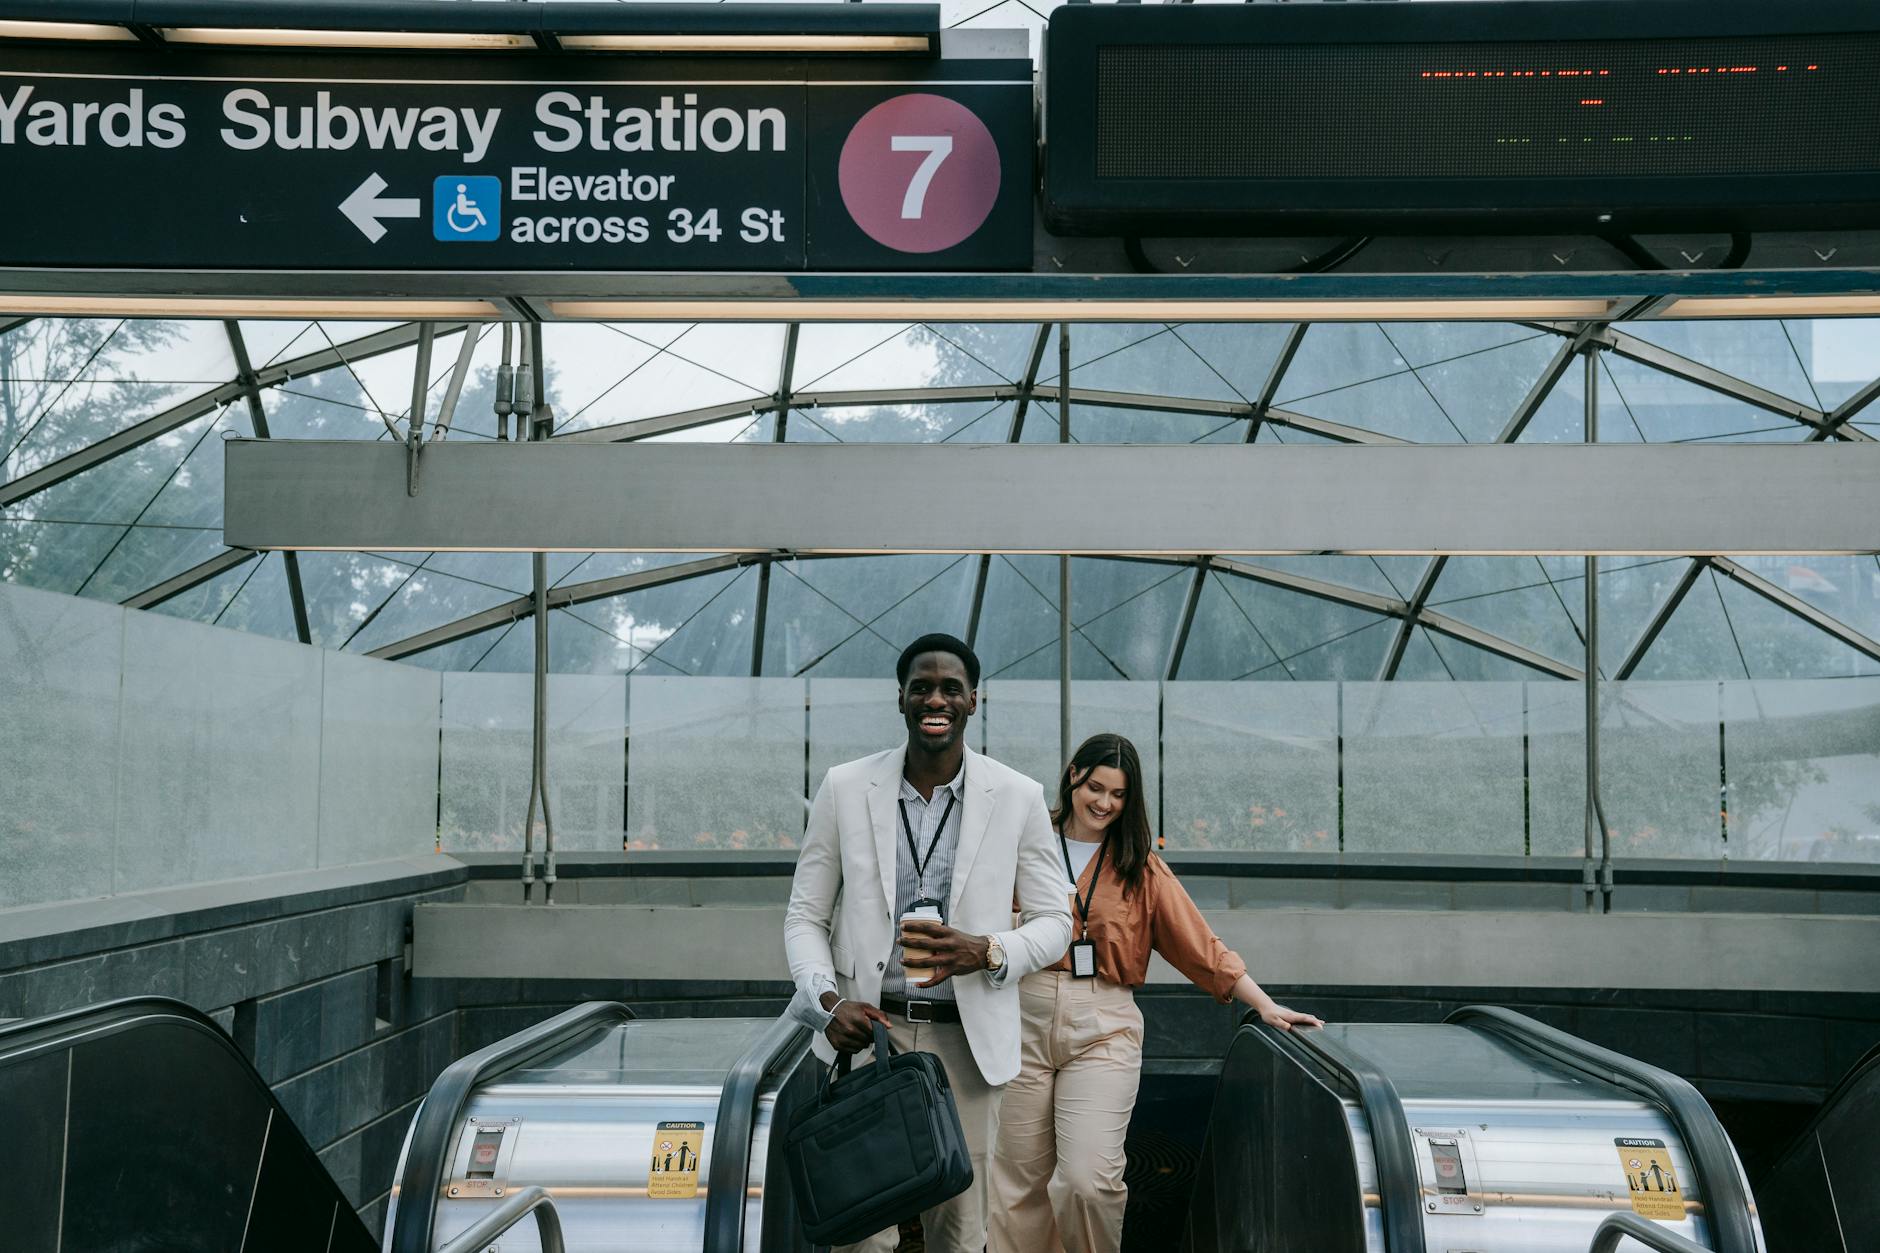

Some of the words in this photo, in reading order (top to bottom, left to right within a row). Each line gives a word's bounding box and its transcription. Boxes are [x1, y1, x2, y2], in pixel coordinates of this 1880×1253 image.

[0, 86, 186, 148] Yards
[220, 88, 501, 163] Subway
[533, 91, 786, 153] Station
[511, 167, 676, 202] Elevator
[891, 136, 953, 219] 7
[510, 216, 650, 244] across
[667, 208, 722, 243] 34
[740, 208, 785, 243] St
[466, 1181, 488, 1189] STOP
[1443, 1197, 1465, 1205] STOP
